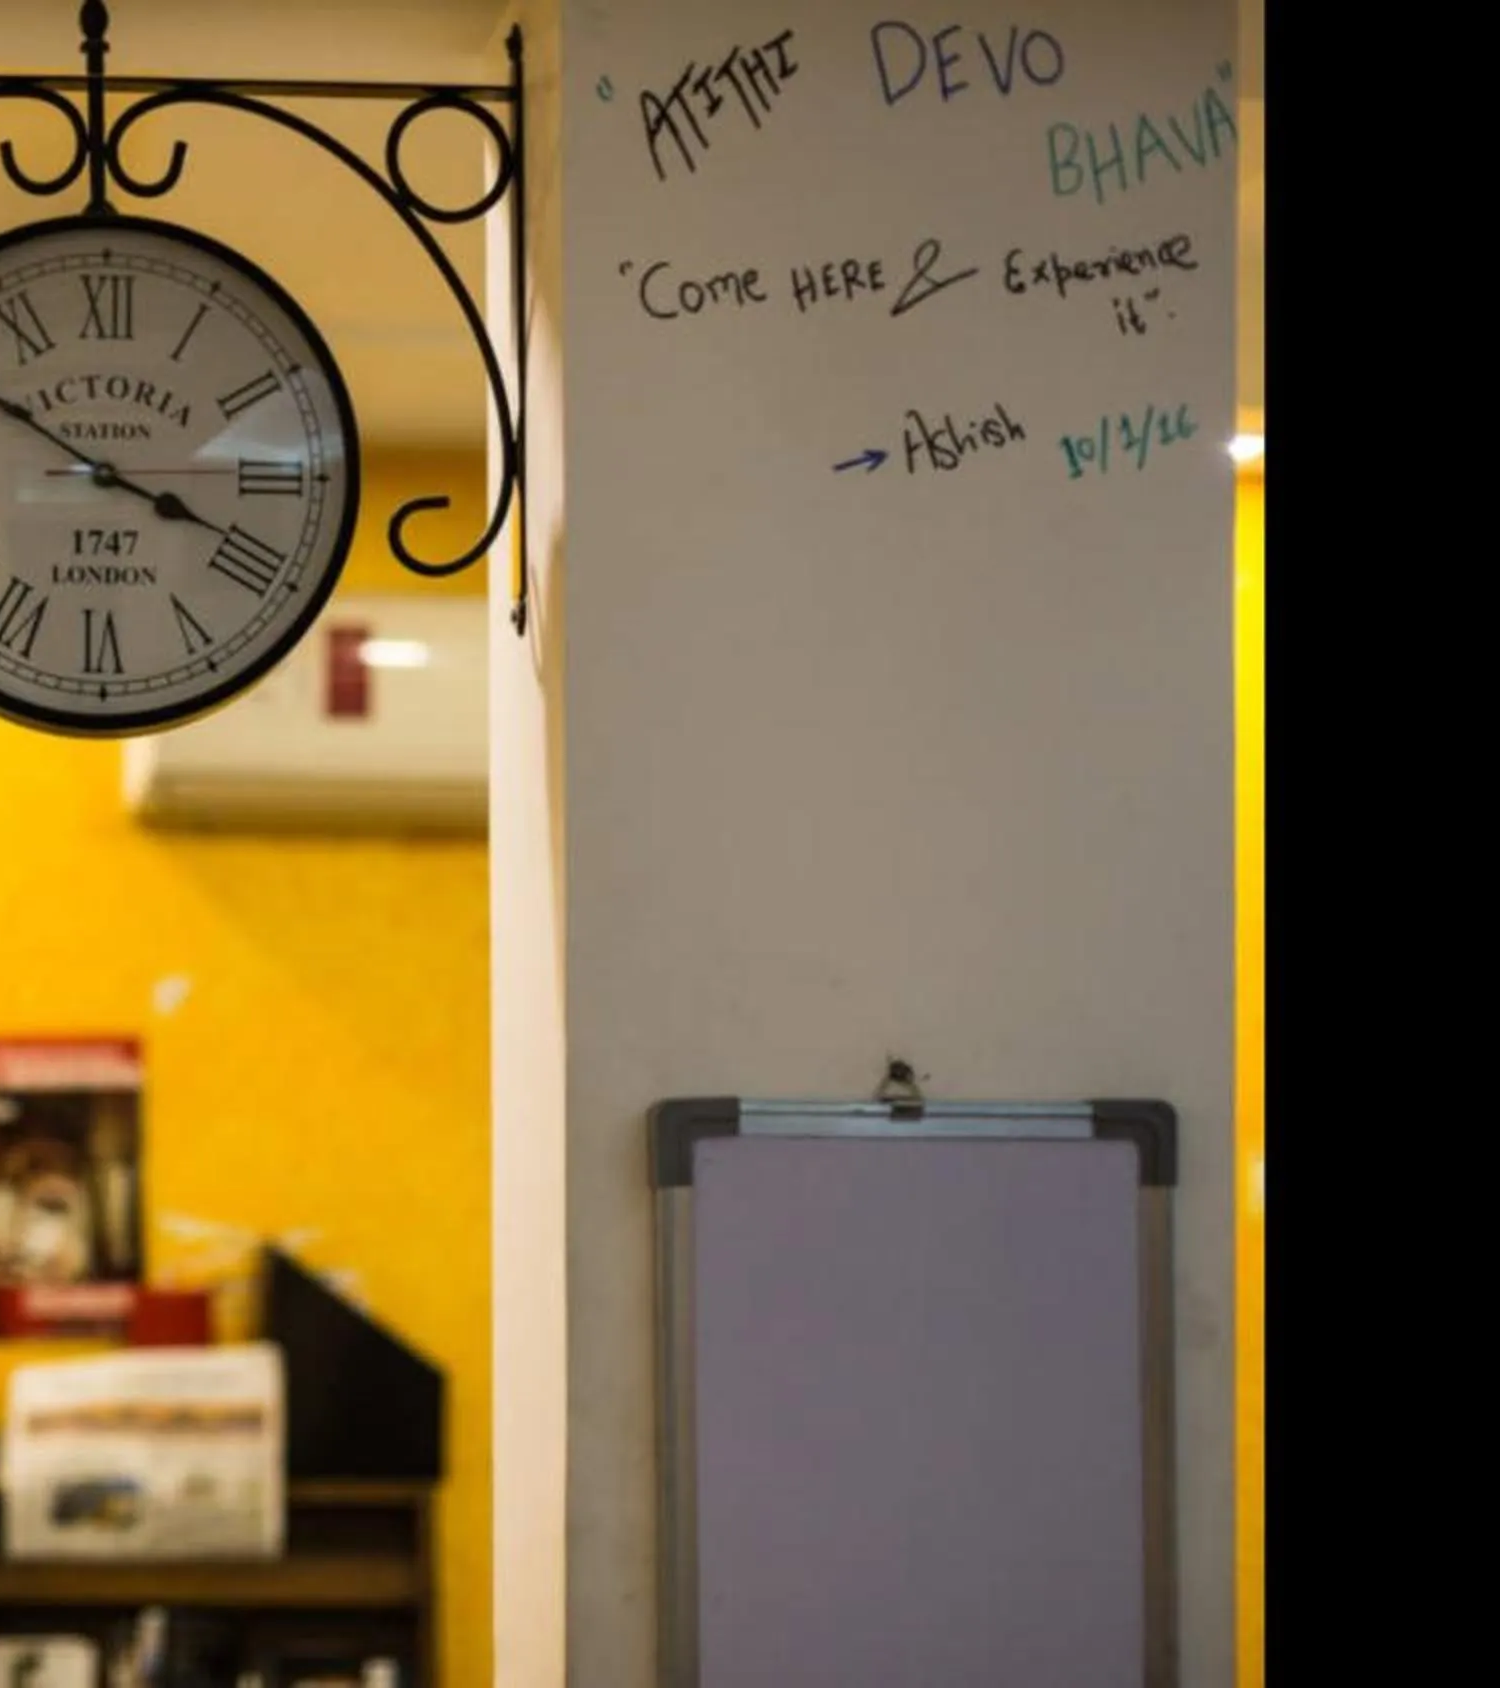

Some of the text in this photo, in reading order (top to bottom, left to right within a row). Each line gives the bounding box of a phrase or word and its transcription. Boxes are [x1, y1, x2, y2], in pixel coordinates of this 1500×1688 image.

[870, 20, 1064, 107] DEVO
[79, 274, 135, 340] XII
[791, 258, 886, 314] HERE
[216, 368, 284, 420] II
[60, 421, 152, 441] STATION
[904, 402, 1027, 471] Ashish
[238, 459, 303, 497] III
[72, 528, 140, 555] 1747
[51, 565, 157, 586] LONDON
[82, 608, 125, 675] VI
